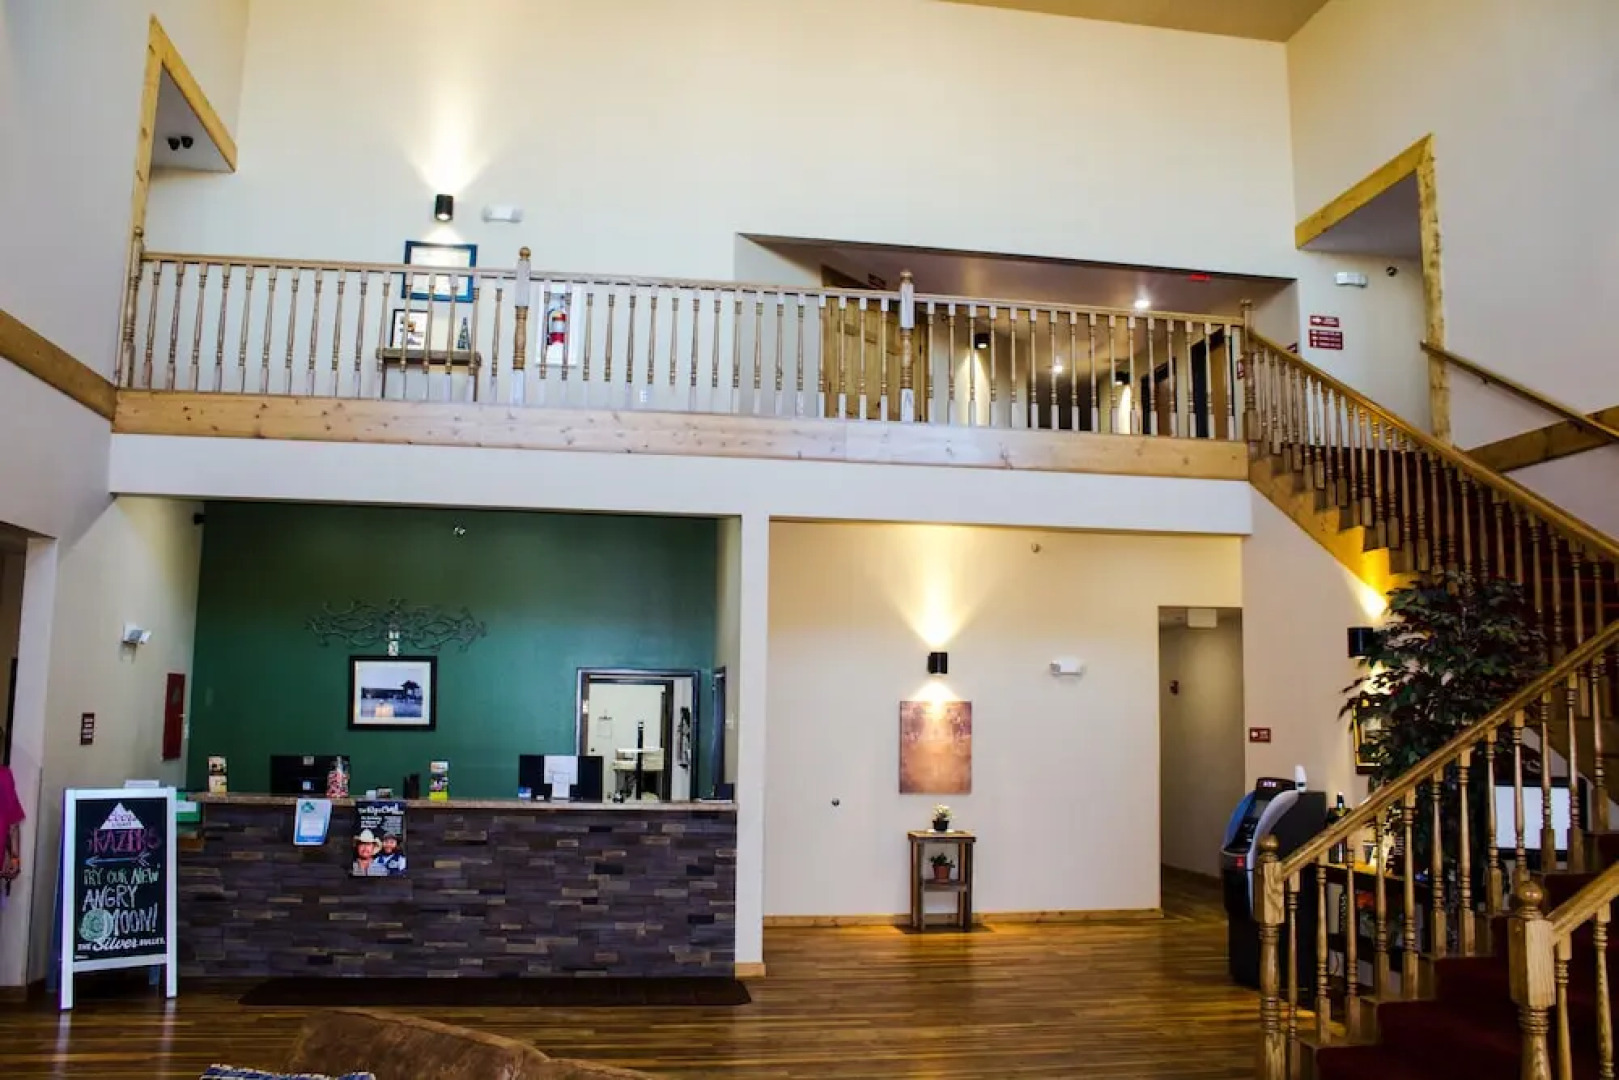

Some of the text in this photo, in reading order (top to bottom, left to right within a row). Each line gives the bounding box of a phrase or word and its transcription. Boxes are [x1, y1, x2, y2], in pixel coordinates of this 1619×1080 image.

[83, 867, 104, 886] TRY
[106, 867, 128, 885] OUR
[82, 884, 139, 912] ANGRY
[92, 937, 139, 952] Silver
